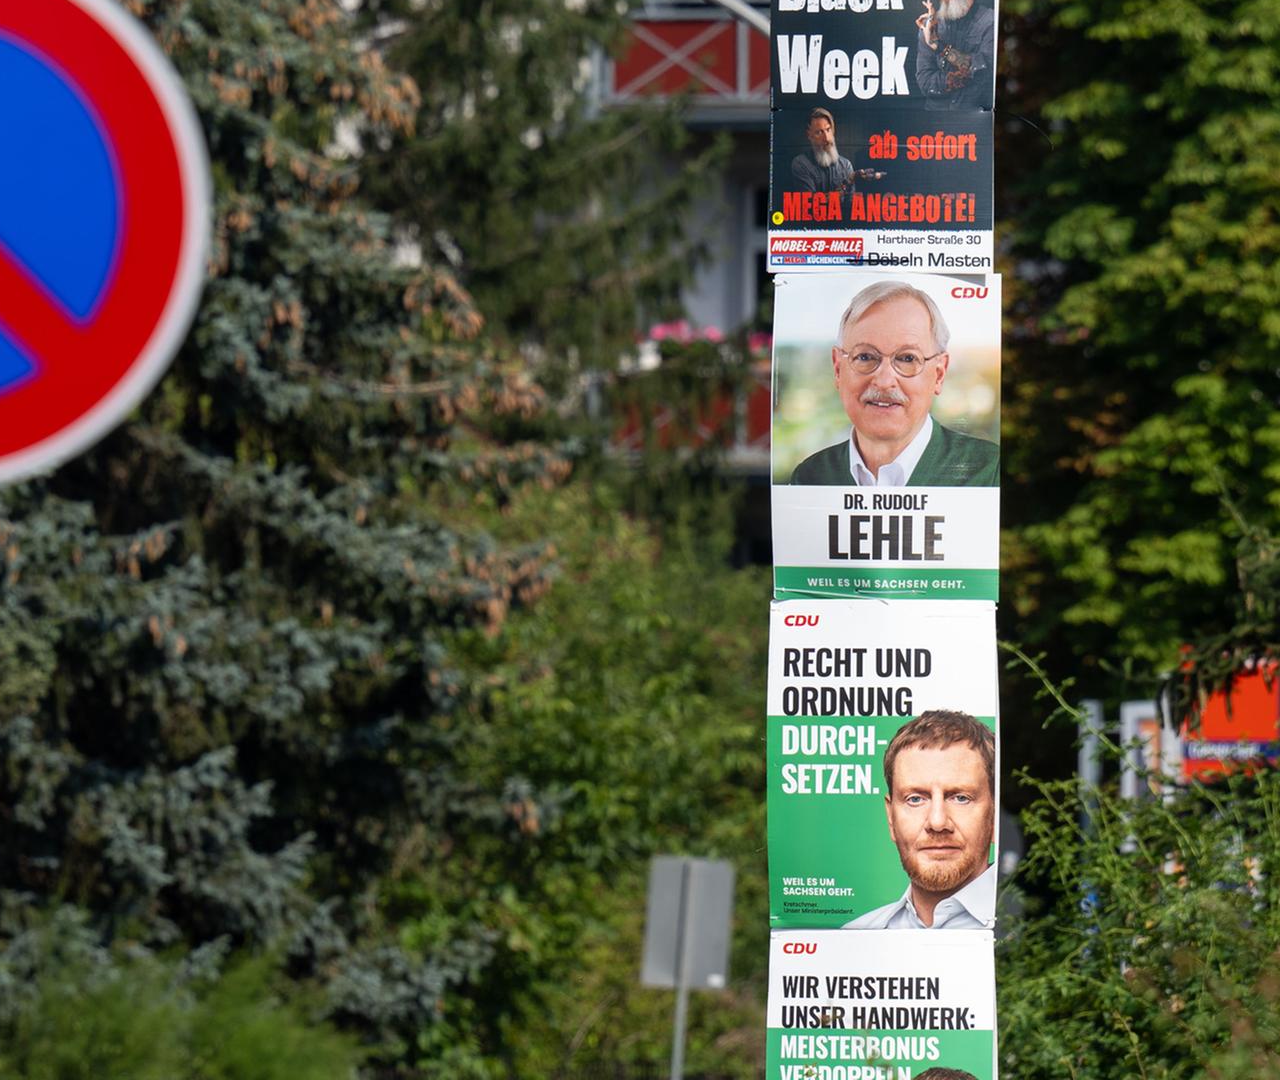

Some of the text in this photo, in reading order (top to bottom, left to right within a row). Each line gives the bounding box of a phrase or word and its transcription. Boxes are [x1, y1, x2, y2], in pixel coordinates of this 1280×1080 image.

[776, 34, 910, 100] Week
[869, 130, 978, 162] ab sofort
[782, 192, 976, 223] MEGA ANGEBOTE!
[771, 239, 862, 253] MÖBEL-SB-HALLE
[877, 234, 981, 245] Harthaer Straße 30
[868, 252, 991, 267] Döbeln Masten
[951, 286, 988, 299] CDU
[843, 494, 929, 511] DR. RUDOLF
[828, 514, 945, 561] LEHLE
[807, 578, 966, 589] WEIL ES UM SACHSEN GEHT.
[784, 615, 819, 627] CDU
[783, 648, 932, 678] RECHT UND
[782, 686, 913, 717] ORDNUNG
[782, 725, 887, 756] DURCH-
[781, 764, 879, 795] SETZEN.
[782, 877, 835, 886] WEIL ES UM
[783, 887, 855, 897] SACHSEN GEHT.
[782, 942, 817, 954] CDU
[782, 975, 940, 1000] WIR VERSTEHEN
[781, 1005, 975, 1031] UNSER HANDWERK:
[780, 1035, 940, 1061] MEISTERBONUS
